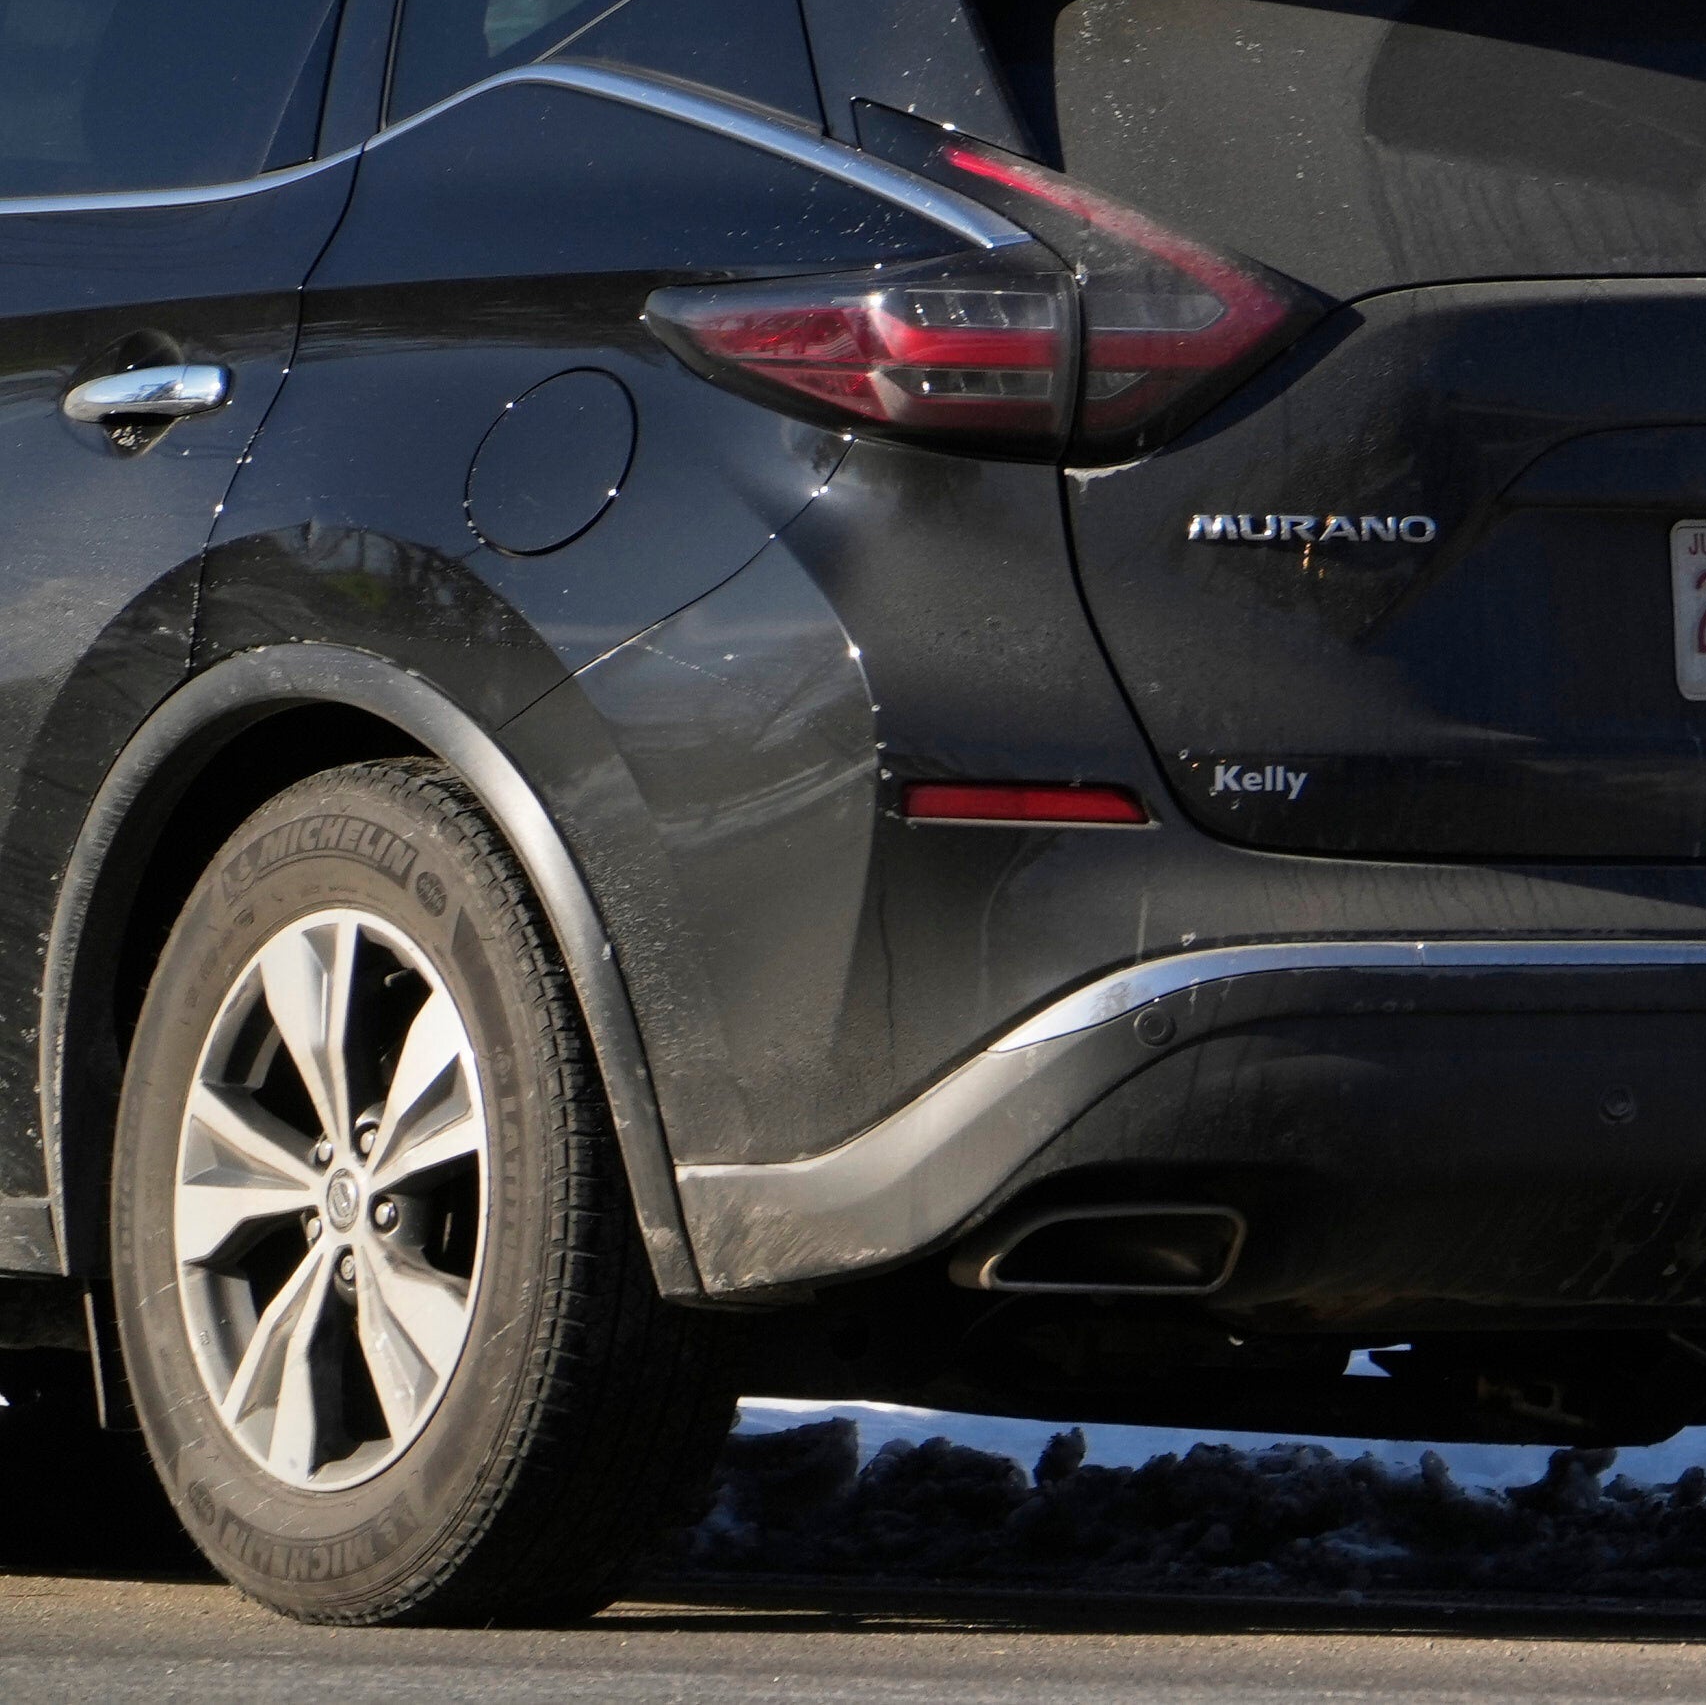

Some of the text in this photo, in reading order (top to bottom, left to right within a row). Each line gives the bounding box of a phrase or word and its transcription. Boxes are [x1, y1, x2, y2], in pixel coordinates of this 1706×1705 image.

[1187, 513, 1437, 544] MURANO
[1214, 764, 1309, 801] Kelly
[257, 814, 418, 882] MICHELIN
